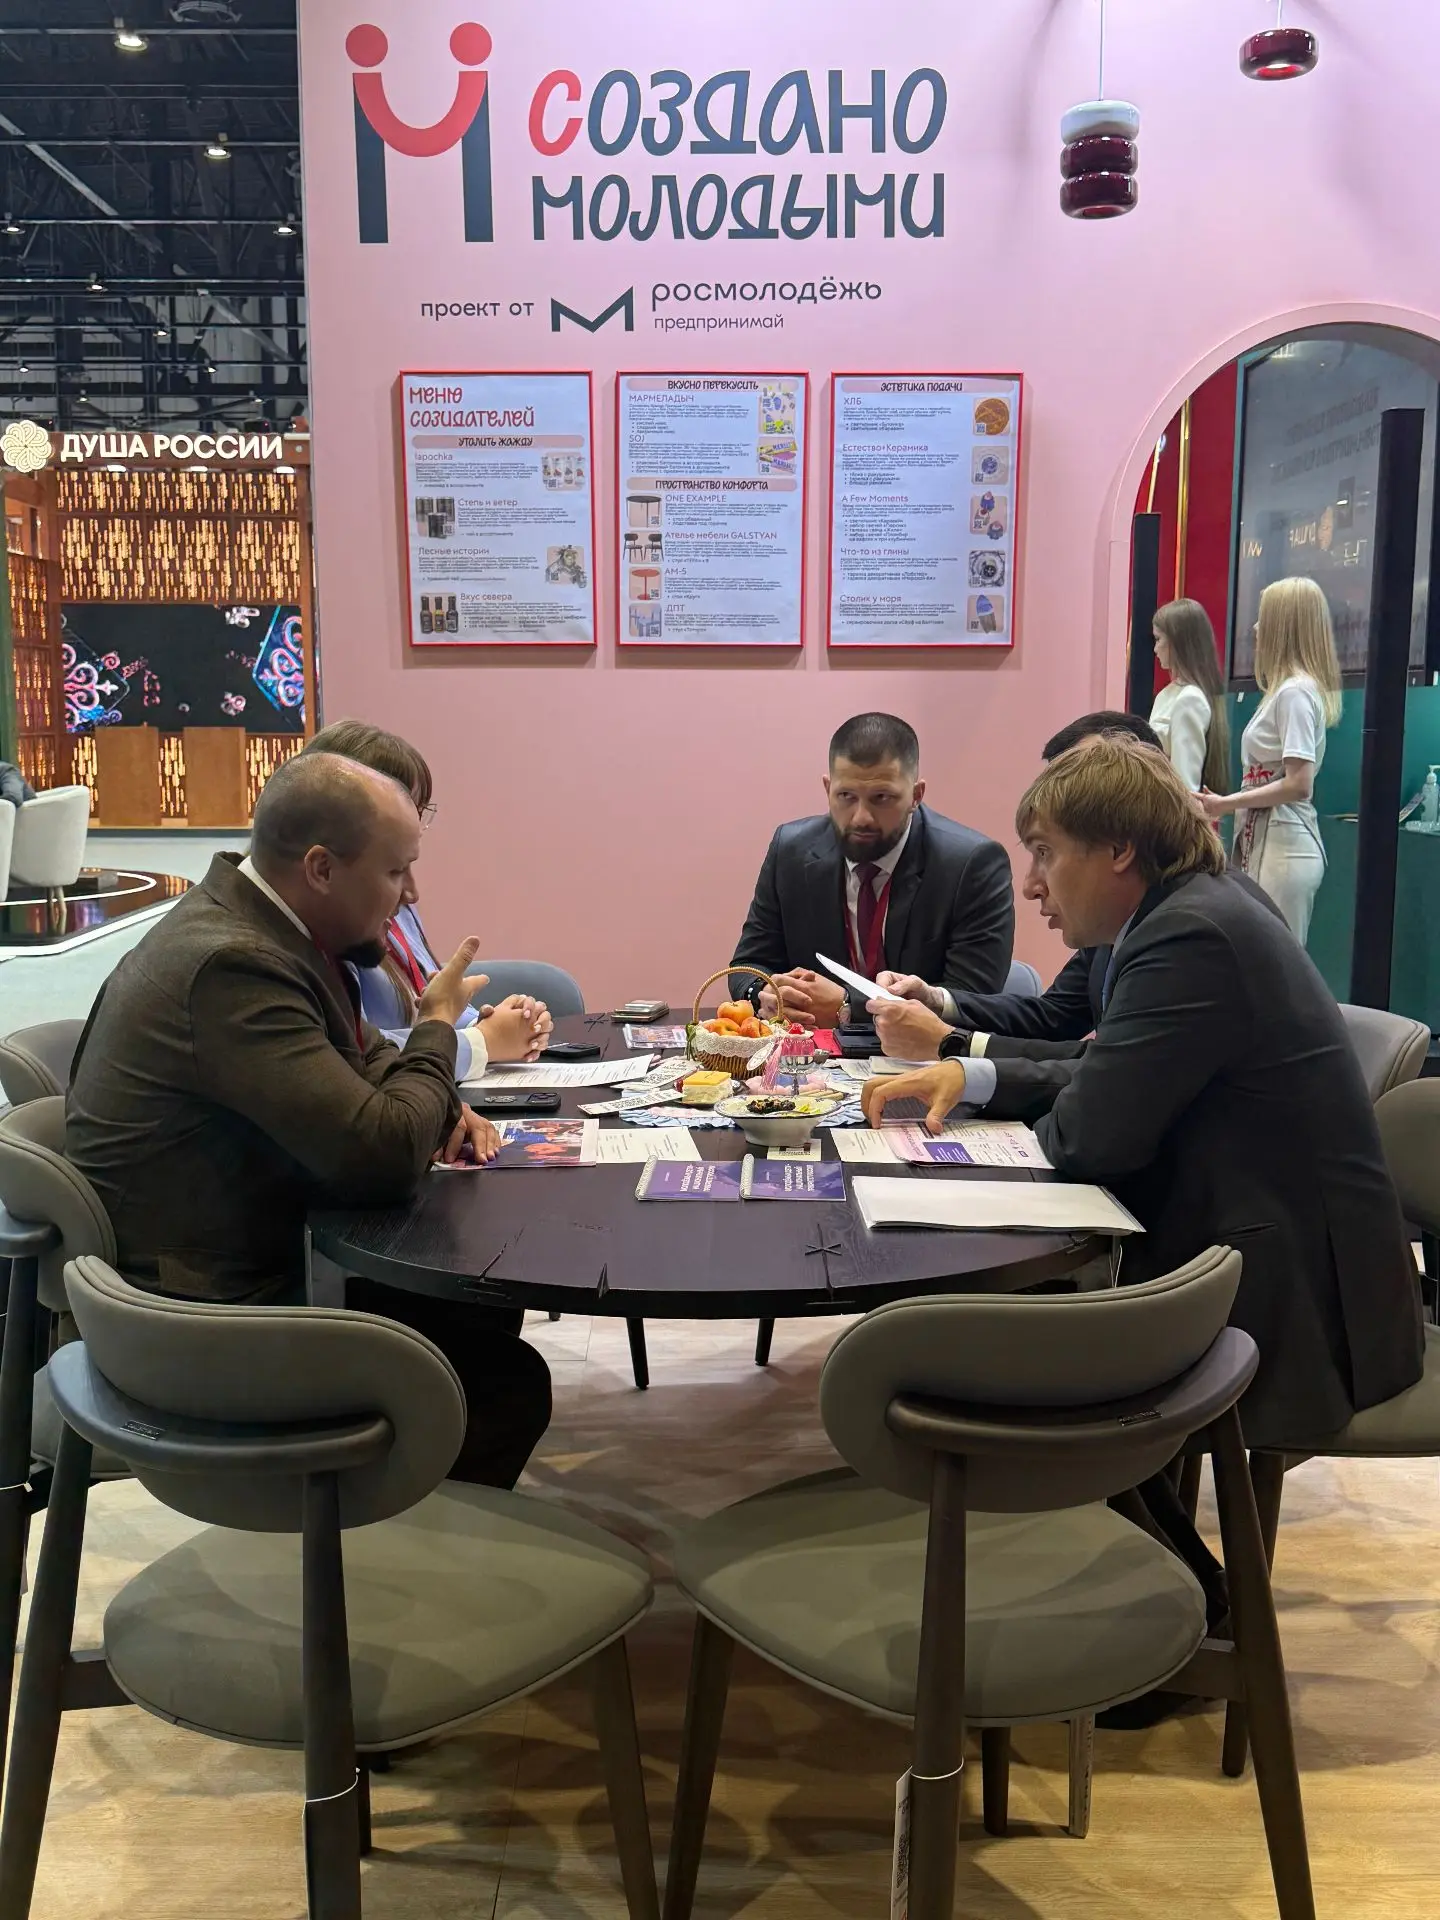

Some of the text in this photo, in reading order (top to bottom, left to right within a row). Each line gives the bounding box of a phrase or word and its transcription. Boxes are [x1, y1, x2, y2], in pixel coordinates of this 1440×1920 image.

[528, 68, 947, 157] СОЗДАНО
[532, 173, 945, 242] МОЛОДЫМИ
[651, 276, 882, 311] росмолодёжь
[421, 299, 534, 322] проект от
[653, 313, 784, 332] предпринимай
[667, 379, 759, 390] ВКУСНО ПЕРЕКУСИТЬ
[880, 382, 963, 392] ЭСТЕТИКА ПОДАЧИ
[628, 394, 695, 403] МАРМЕЛАДЫЧ
[458, 437, 533, 447] УТОЛИТЬ ЖАЖДУ
[60, 434, 283, 463] ДУША РОССИИ
[415, 452, 453, 463] lapochka
[655, 480, 769, 491] ПРОСТРАНСТВО КОМФОРТА
[665, 495, 727, 503] ONE EXAMPLE
[730, 531, 778, 540] GALSTYAN
